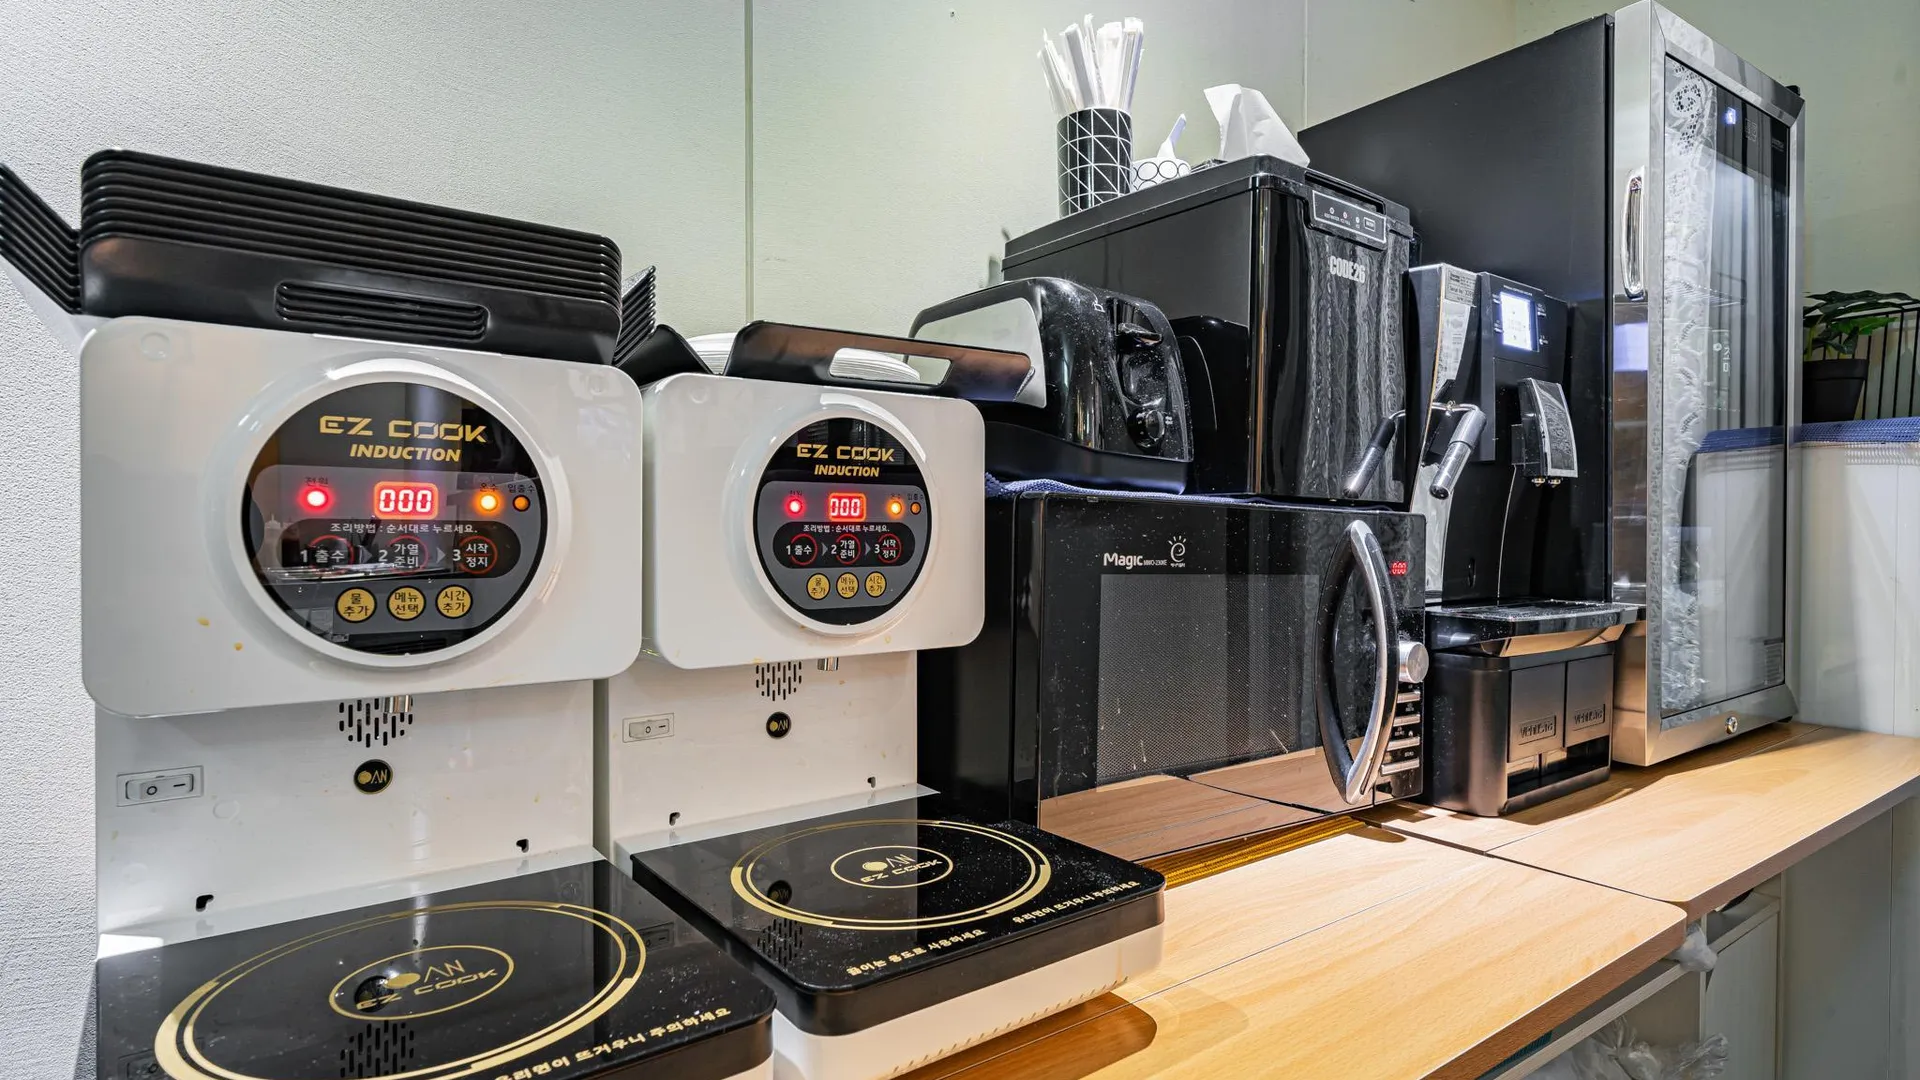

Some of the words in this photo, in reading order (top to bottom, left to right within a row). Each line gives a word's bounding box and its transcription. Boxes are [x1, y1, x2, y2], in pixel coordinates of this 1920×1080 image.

[1329, 255, 1366, 284] CODE26
[319, 415, 374, 436] EZ
[388, 420, 487, 443] COOK
[350, 444, 462, 462] INDUCTION
[797, 443, 829, 459] EZ
[837, 445, 895, 462] COOK
[814, 464, 880, 477] INDUCTION
[379, 489, 432, 513] 000
[830, 498, 860, 516] 000
[330, 523, 376, 534] 조리방법
[386, 524, 429, 534] 순서대로
[433, 524, 478, 534] 누르세요.
[803, 525, 831, 533] 조리방법
[835, 525, 861, 533] 순서대로
[862, 525, 890, 533] 누르세요.
[394, 543, 419, 556] 가열
[465, 543, 488, 554] 시작
[840, 540, 855, 549] 가열
[874, 544, 881, 554] 3
[882, 539, 896, 548] 시작
[378, 550, 388, 562] 2
[452, 549, 461, 561] 3
[785, 545, 791, 555] 1
[831, 545, 838, 555] 2
[840, 549, 855, 559] 준비
[882, 549, 896, 558] 정지
[300, 550, 308, 562] 1
[315, 550, 345, 563] 출수
[394, 556, 419, 567] 준비
[465, 556, 488, 567] 정지
[1103, 552, 1143, 570] Magic
[351, 593, 362, 605] 물
[394, 592, 419, 603] 메뉴
[443, 590, 466, 602] 시간
[343, 605, 369, 616] 추가
[394, 604, 419, 615] 선택
[442, 602, 466, 613] 추가
[860, 872, 889, 883] EZ
[892, 859, 943, 875] COOK
[1054, 894, 1095, 911] 뜨거우니
[928, 929, 988, 950] 사용하세요
[355, 993, 402, 1011] EZ
[413, 968, 498, 996] COOK
[574, 1032, 647, 1063] 뜨거우니
[649, 1007, 732, 1039] 주의하세요
